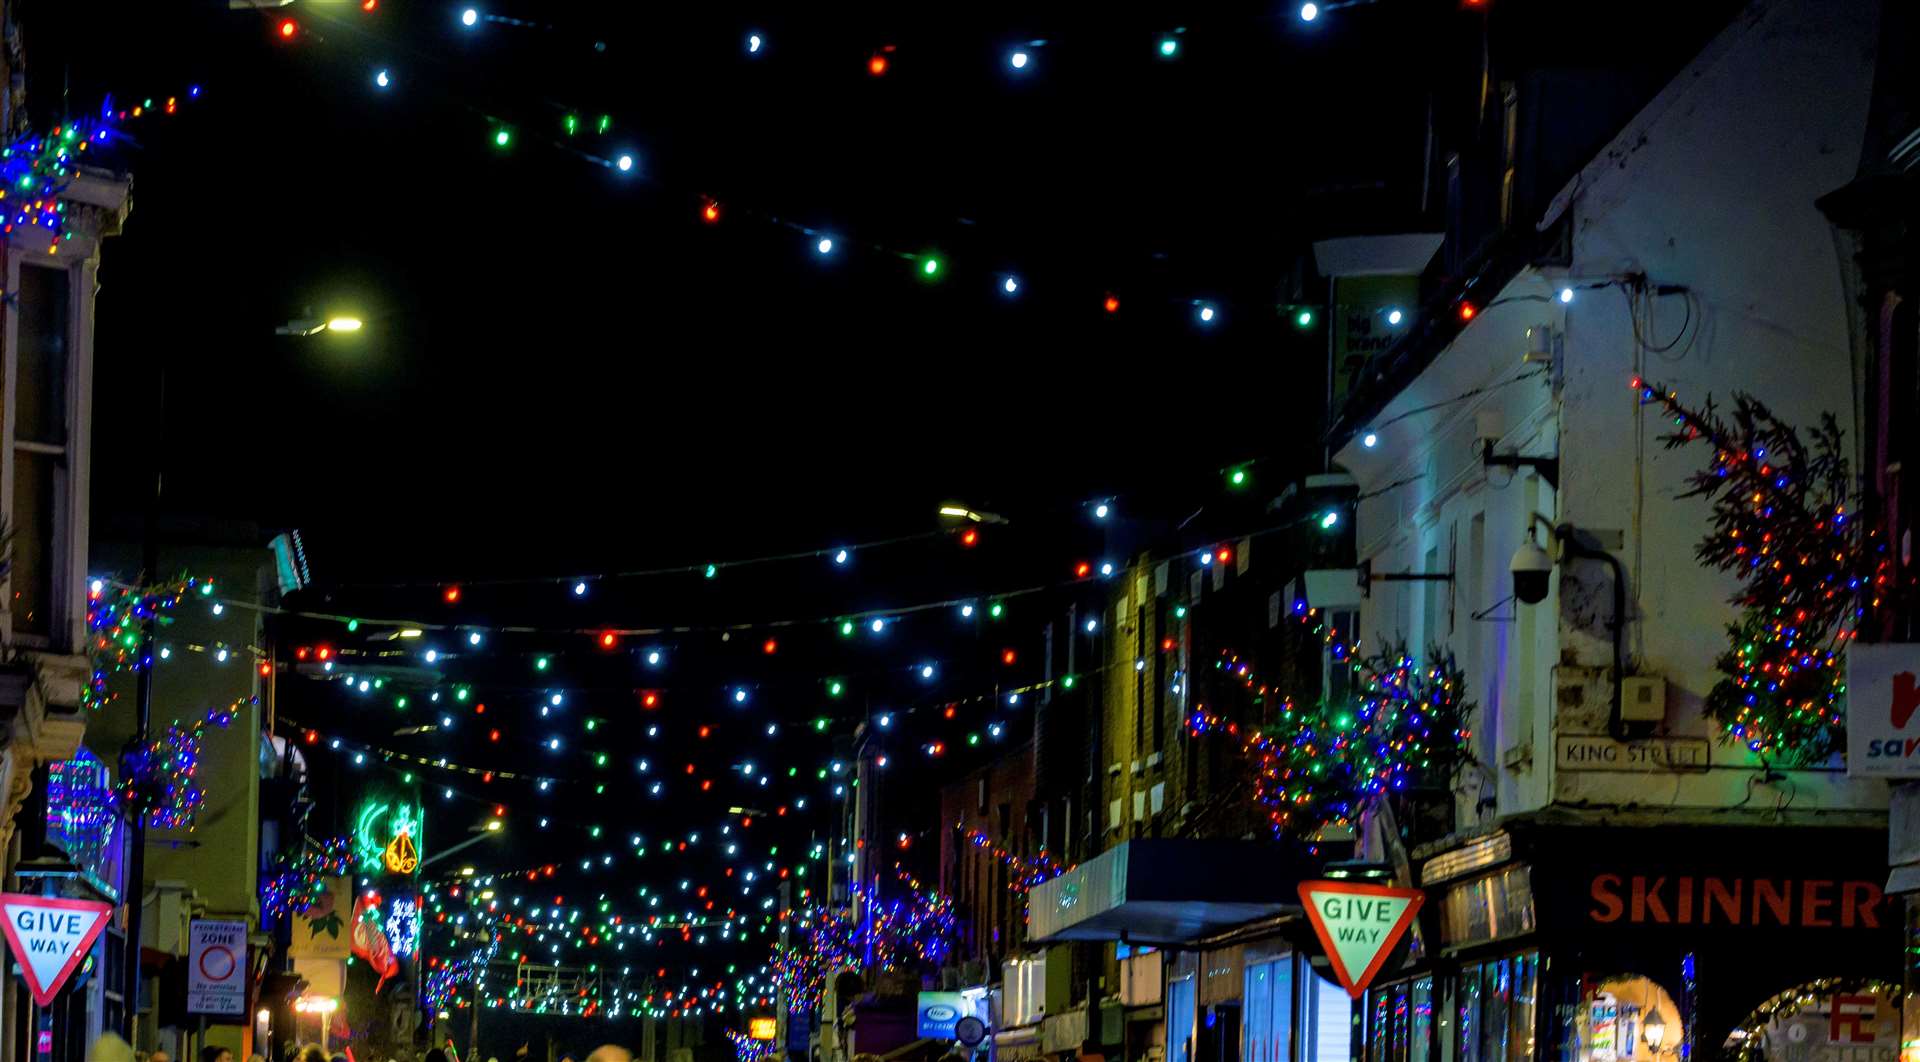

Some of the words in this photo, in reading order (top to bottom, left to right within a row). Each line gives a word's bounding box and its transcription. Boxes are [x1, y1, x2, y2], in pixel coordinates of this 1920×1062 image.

[1567, 744, 1617, 762] KING
[1627, 744, 1698, 764] STREET
[1323, 897, 1392, 923] GIVE
[17, 910, 82, 936] GIVE
[201, 933, 235, 945] ZONE
[1337, 926, 1382, 945] WAY
[30, 938, 71, 955] WAY
